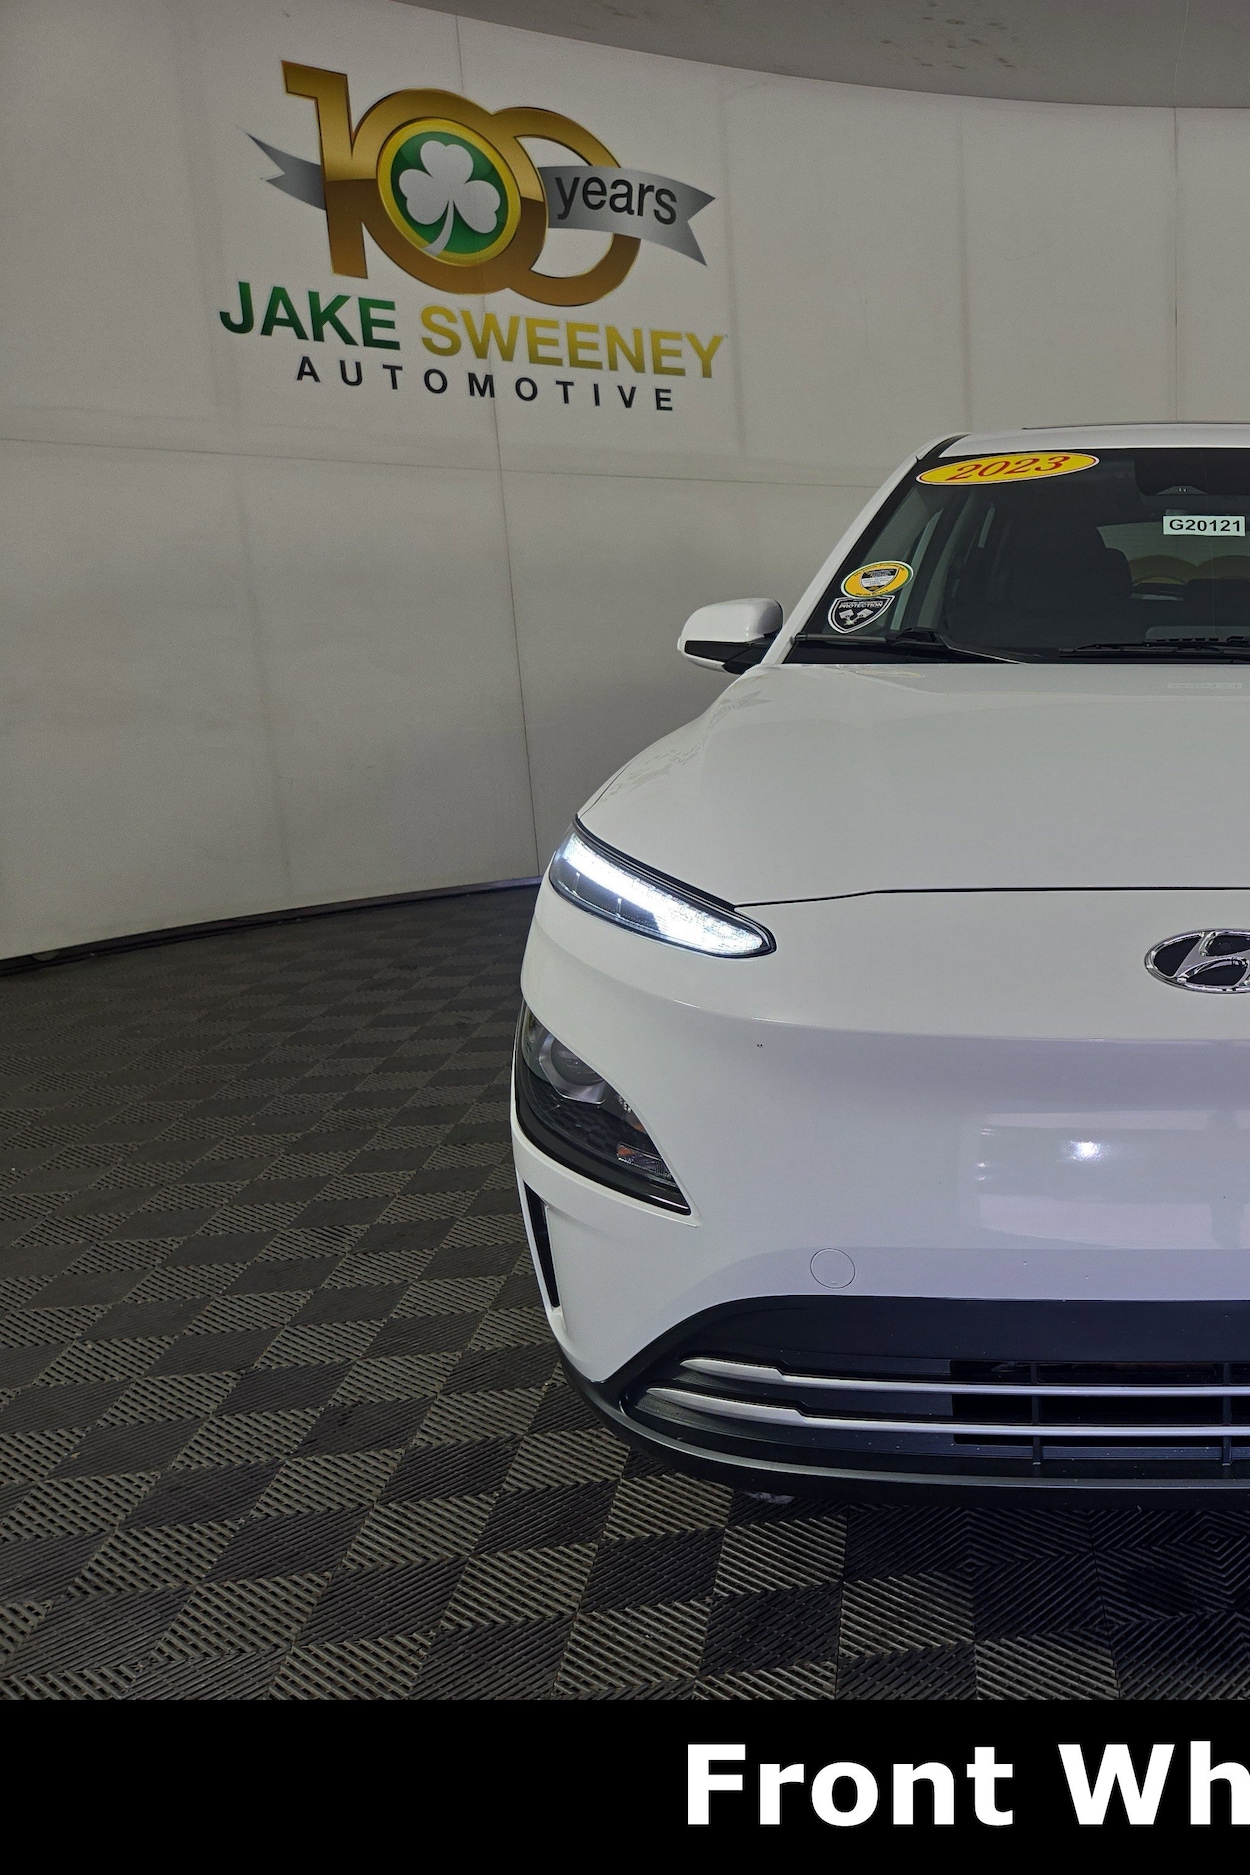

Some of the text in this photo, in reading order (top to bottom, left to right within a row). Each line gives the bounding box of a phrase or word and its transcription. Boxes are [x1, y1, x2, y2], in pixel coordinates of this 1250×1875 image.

[554, 174, 679, 226] years
[219, 280, 724, 379] JAKE SWEENEY
[295, 356, 674, 412] AUTOMOTIVE
[945, 455, 1071, 482] 2023
[1169, 519, 1241, 532] G20121
